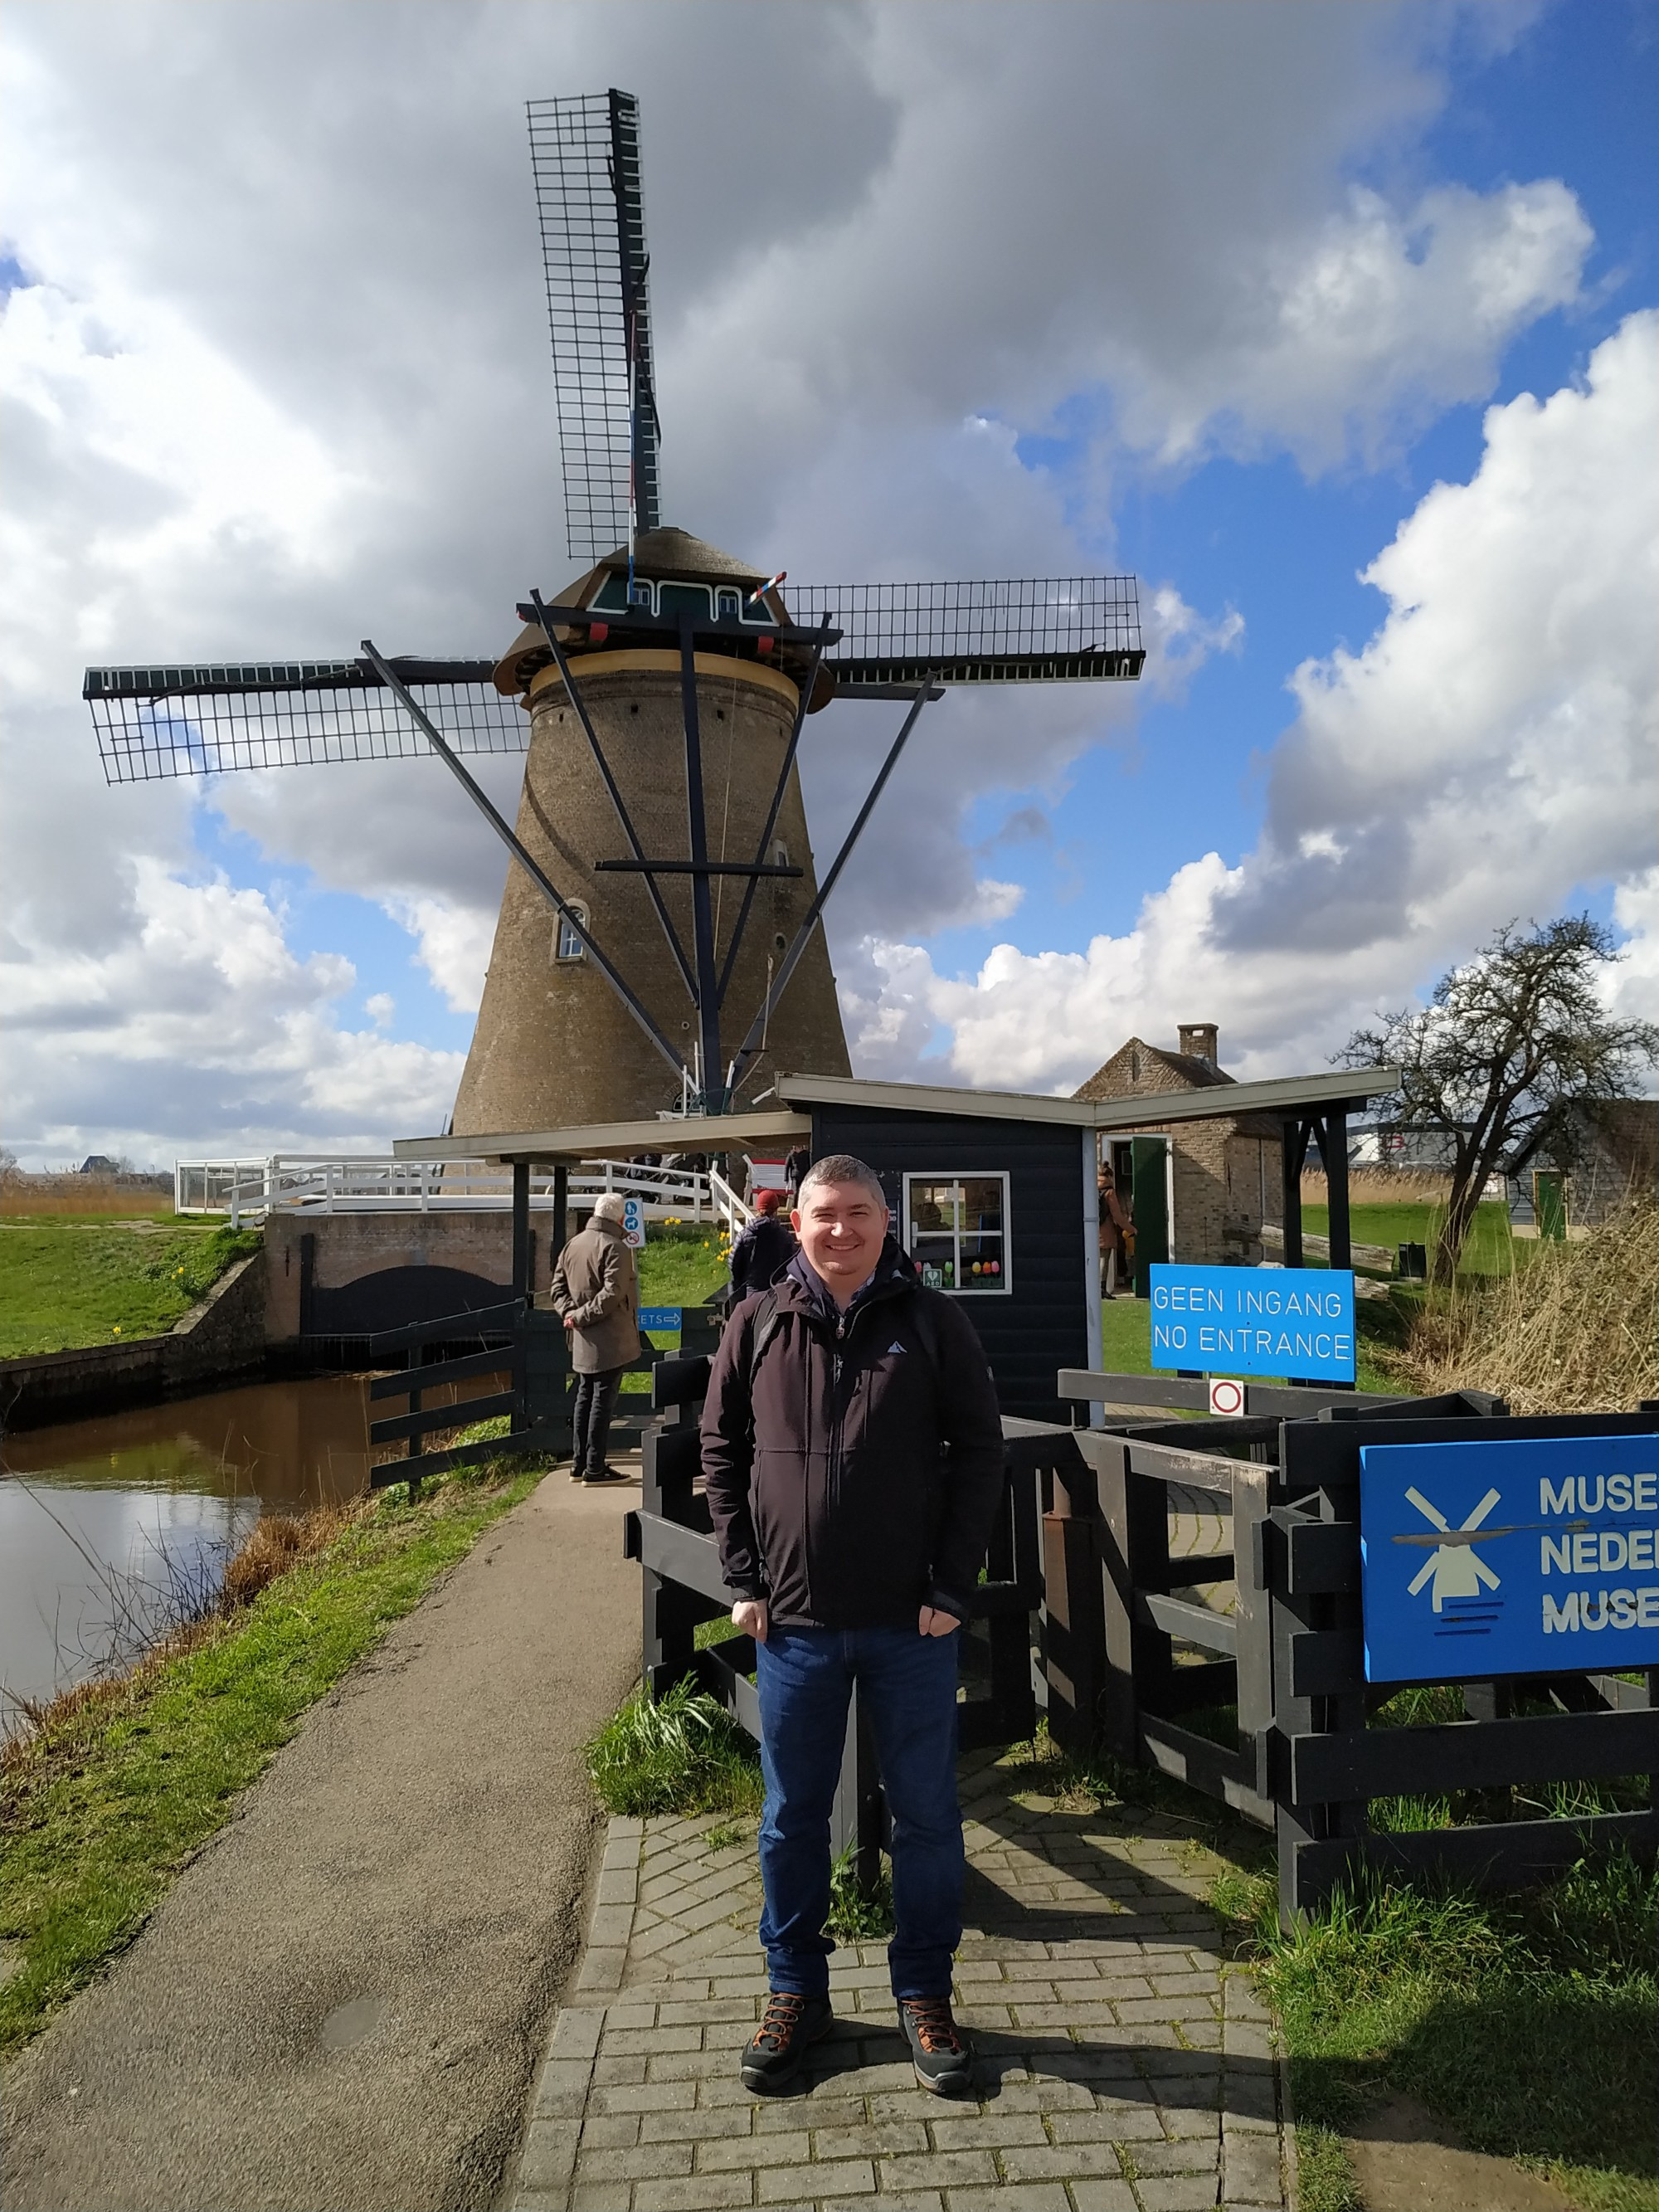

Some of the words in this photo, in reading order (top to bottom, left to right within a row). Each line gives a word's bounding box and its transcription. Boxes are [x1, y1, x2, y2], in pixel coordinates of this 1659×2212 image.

[1154, 1286, 1224, 1312] GEEN
[1238, 1290, 1342, 1318] INGANG
[1154, 1325, 1187, 1349] NO
[1199, 1327, 1351, 1360] ENTRANCE
[1540, 1529, 1659, 1575] NEDE
